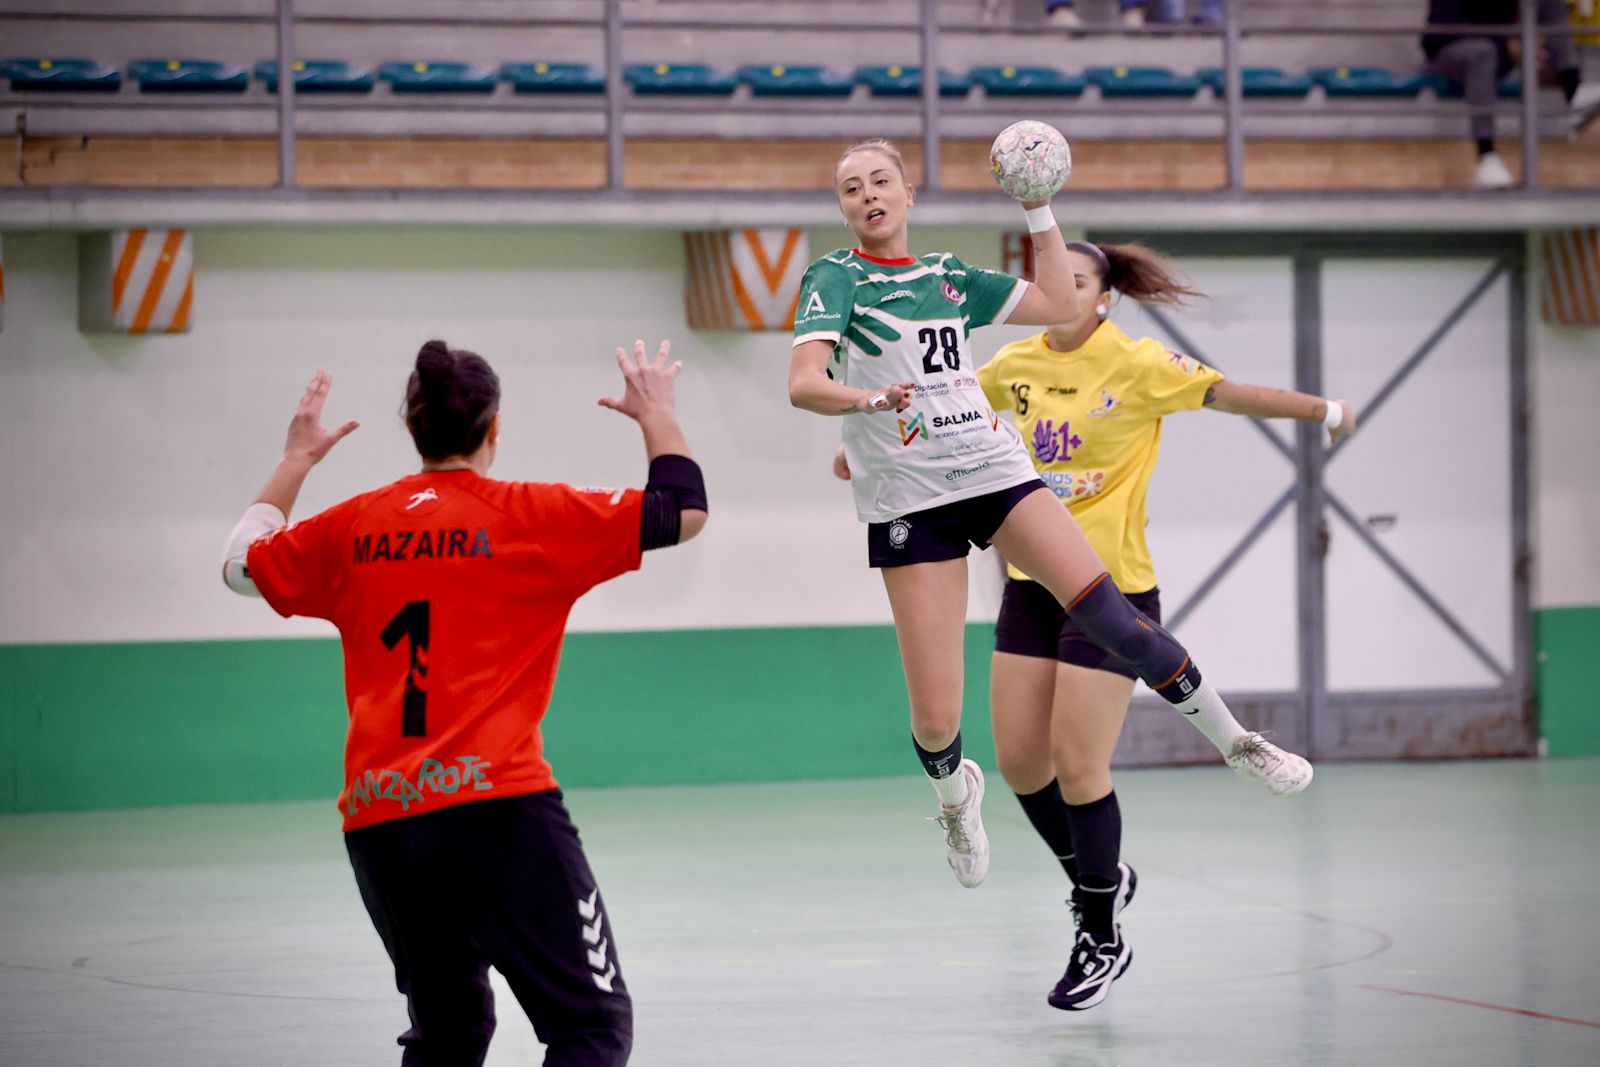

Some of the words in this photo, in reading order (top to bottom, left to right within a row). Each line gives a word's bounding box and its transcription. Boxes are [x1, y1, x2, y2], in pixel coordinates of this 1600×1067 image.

[918, 326, 960, 374] 28
[932, 410, 983, 428] SALMA
[352, 528, 493, 564] MAZAIRA
[379, 599, 431, 737] 1
[346, 755, 494, 816] LANZAROTE
